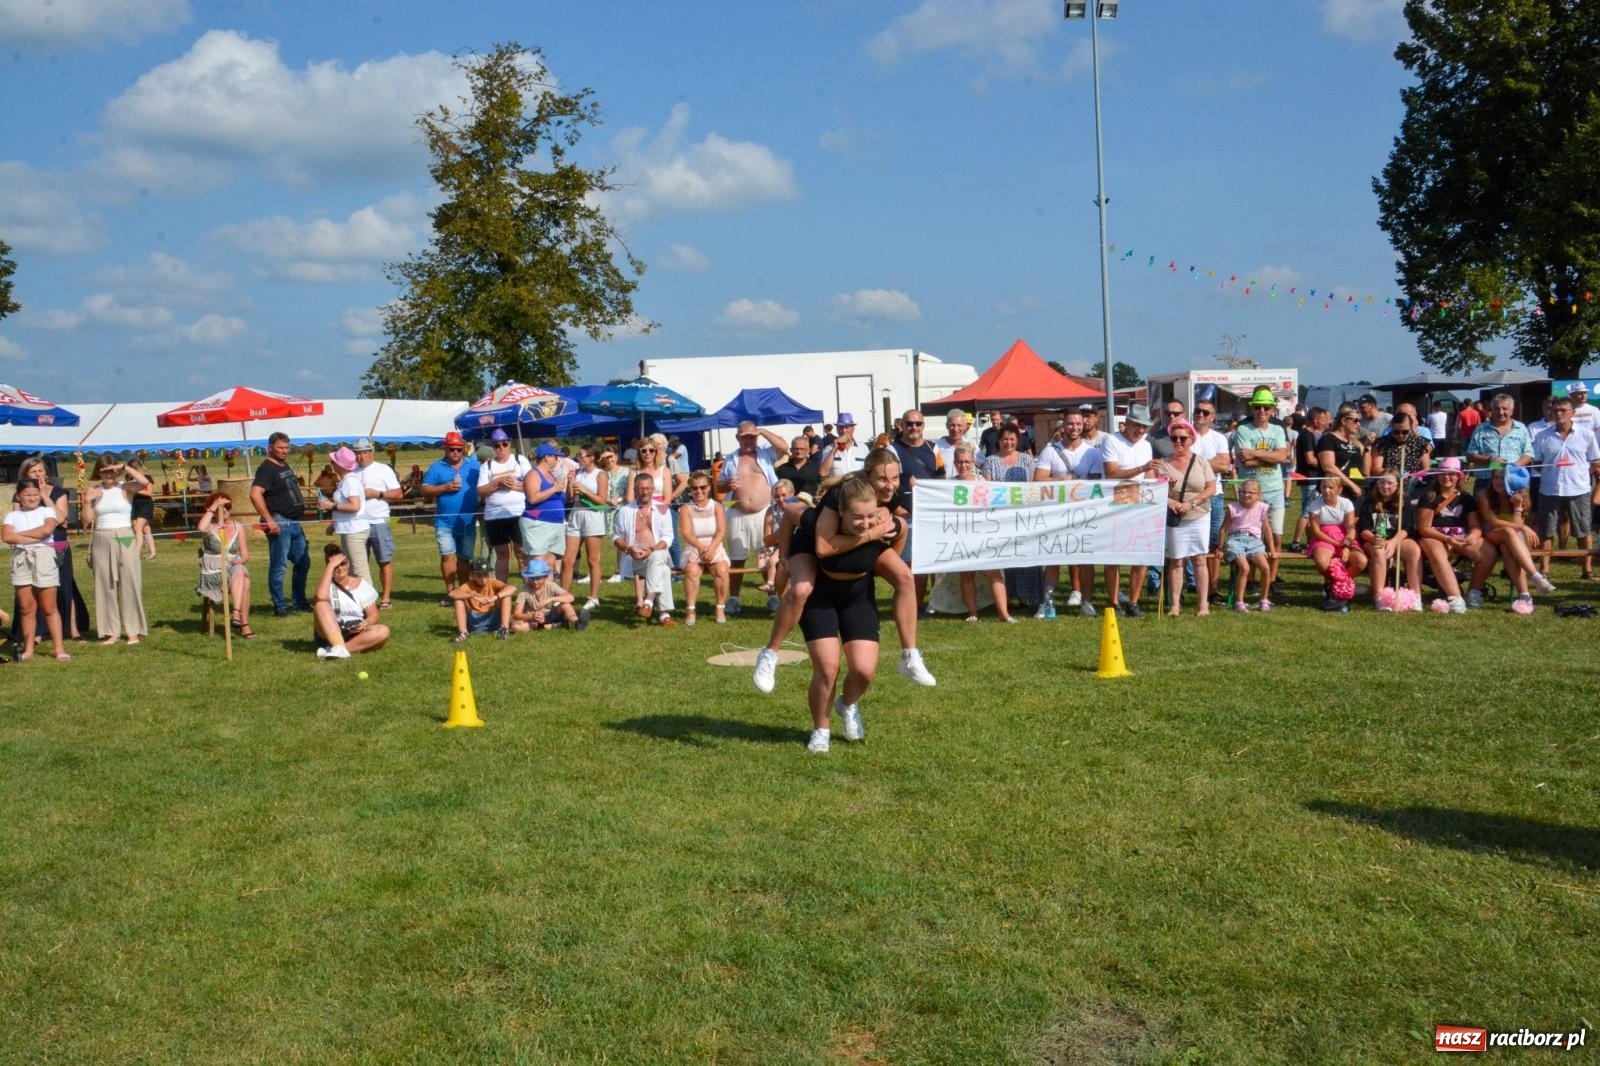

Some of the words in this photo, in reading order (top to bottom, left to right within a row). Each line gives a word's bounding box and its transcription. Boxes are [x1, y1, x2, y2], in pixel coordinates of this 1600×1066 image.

[943, 507, 1000, 535] WIEŚ
[1015, 510, 1048, 531] NA
[1061, 507, 1098, 530] 102
[934, 534, 1027, 562] ZAWSZE
